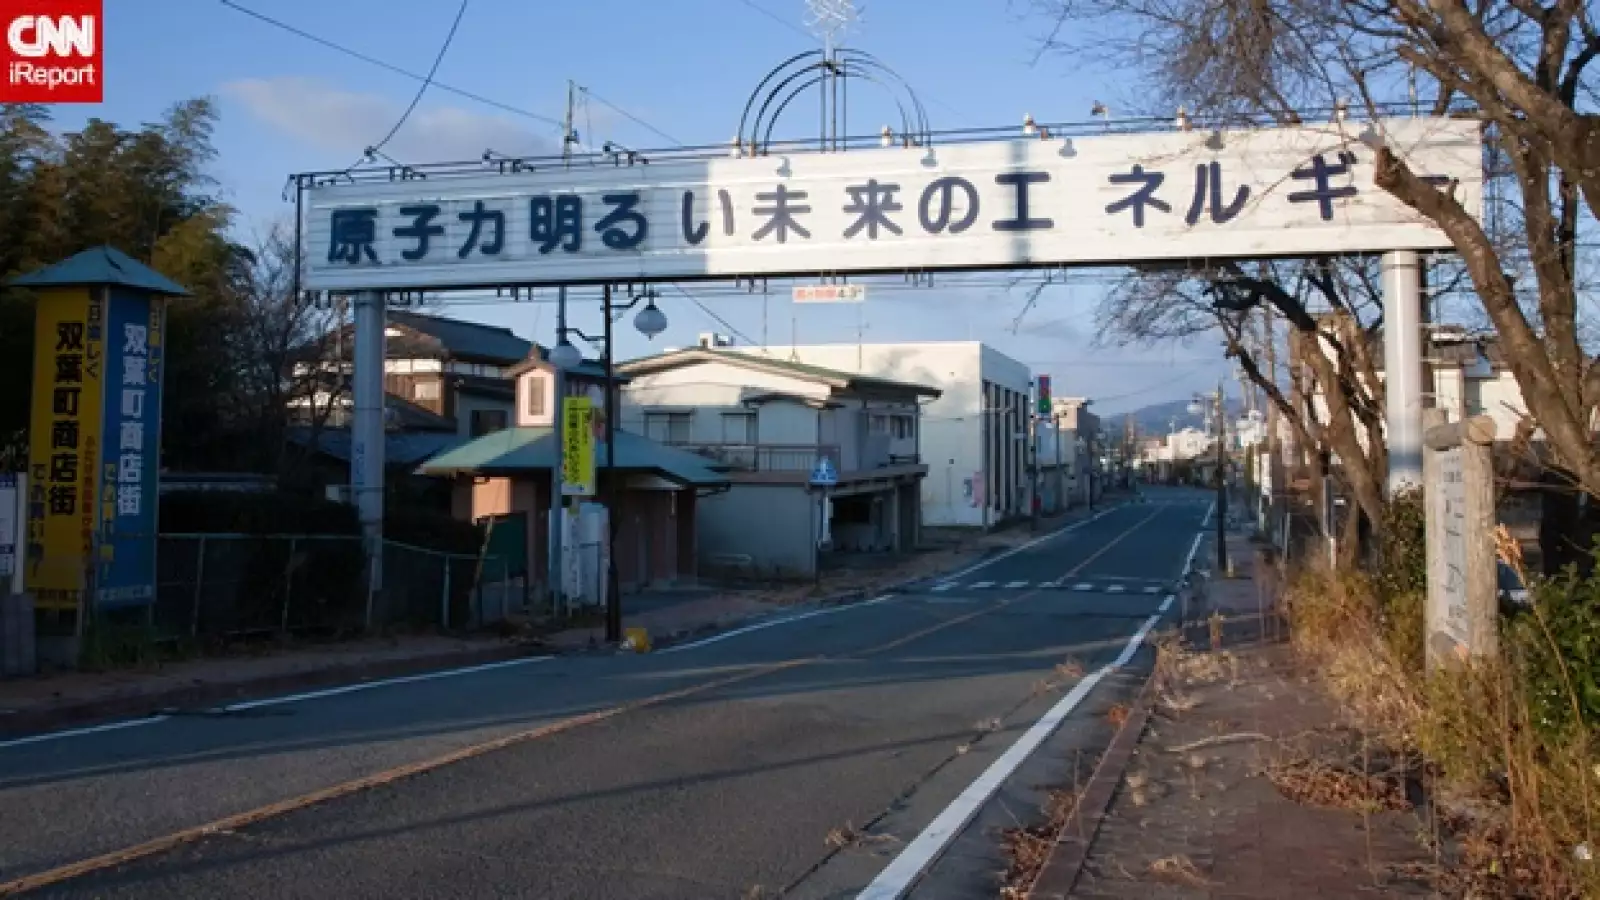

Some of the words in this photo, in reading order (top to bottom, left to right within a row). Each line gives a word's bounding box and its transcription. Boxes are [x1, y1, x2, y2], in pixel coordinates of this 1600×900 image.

[49, 322, 84, 515] 双葉町商店街
[117, 322, 147, 516] 双葉町商店街
